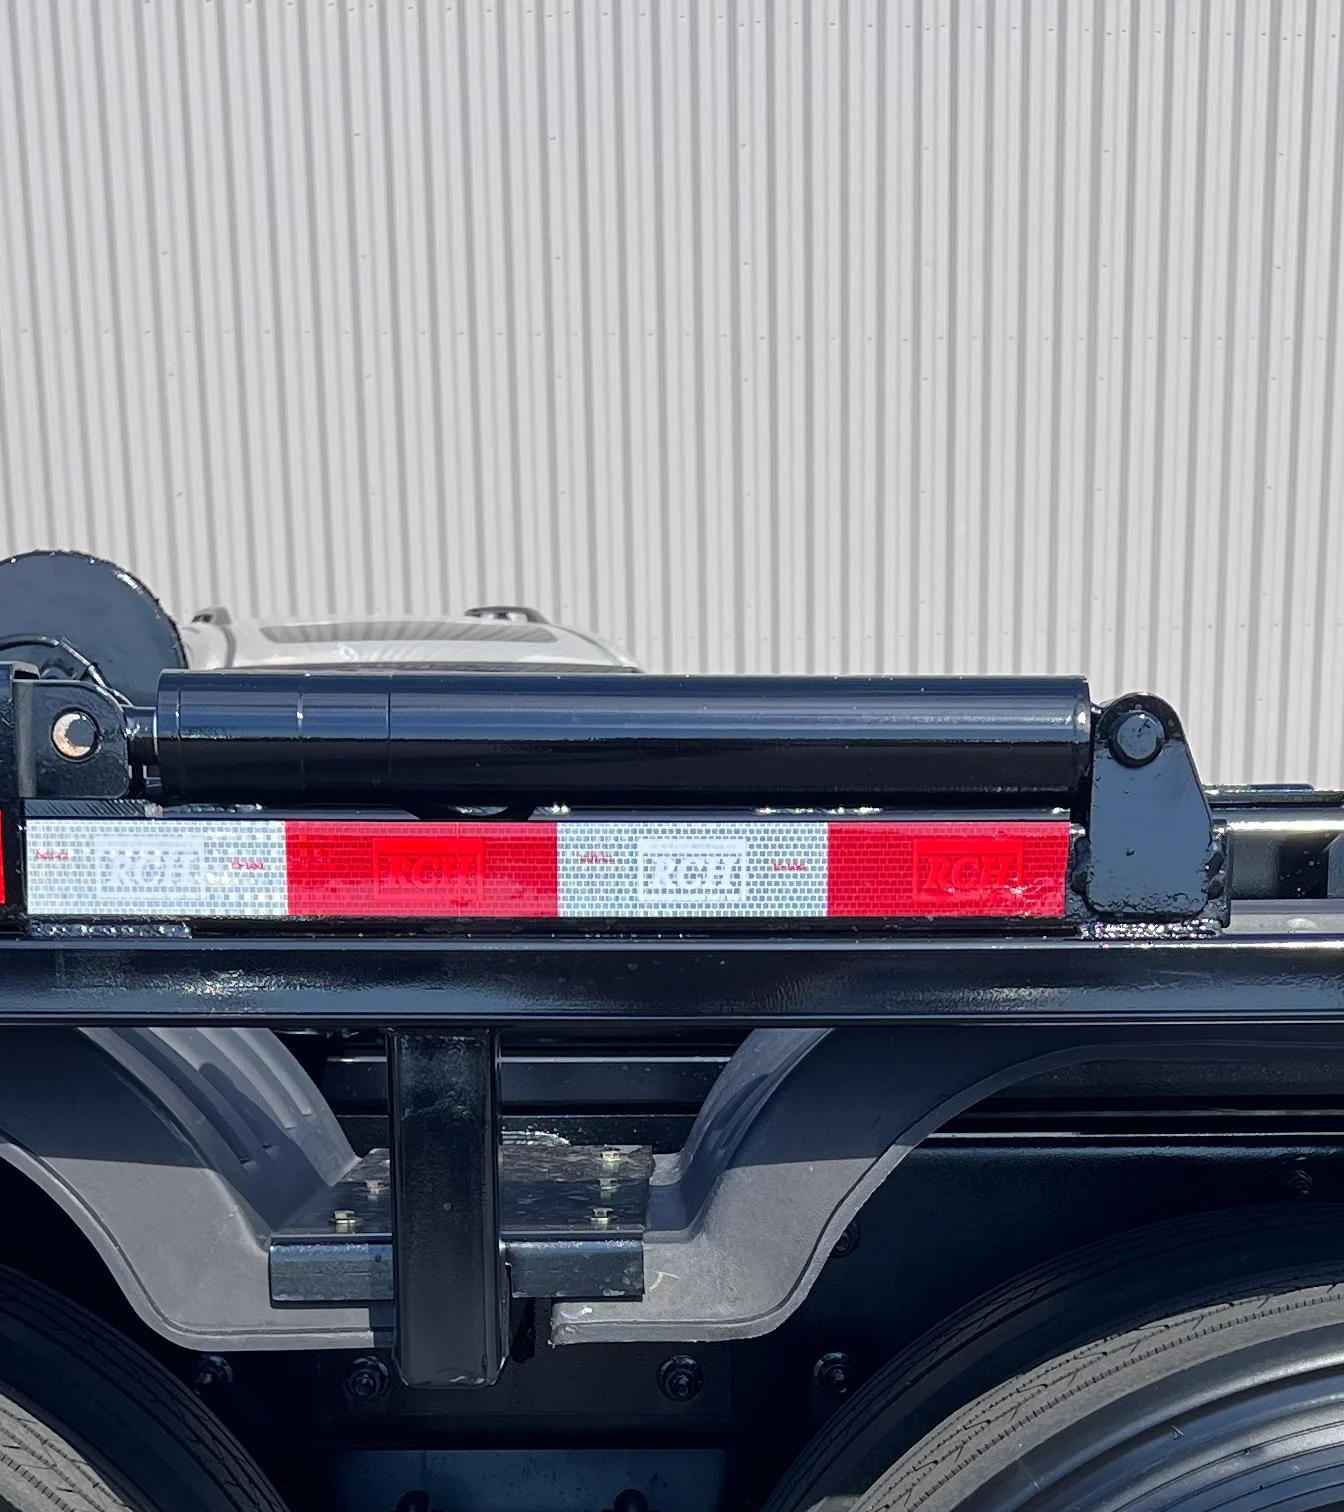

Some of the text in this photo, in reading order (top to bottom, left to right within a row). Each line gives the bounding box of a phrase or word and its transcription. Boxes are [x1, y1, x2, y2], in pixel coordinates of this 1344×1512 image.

[387, 857, 473, 888] RCH
[650, 858, 738, 888] RCH
[926, 857, 1012, 888] RCH
